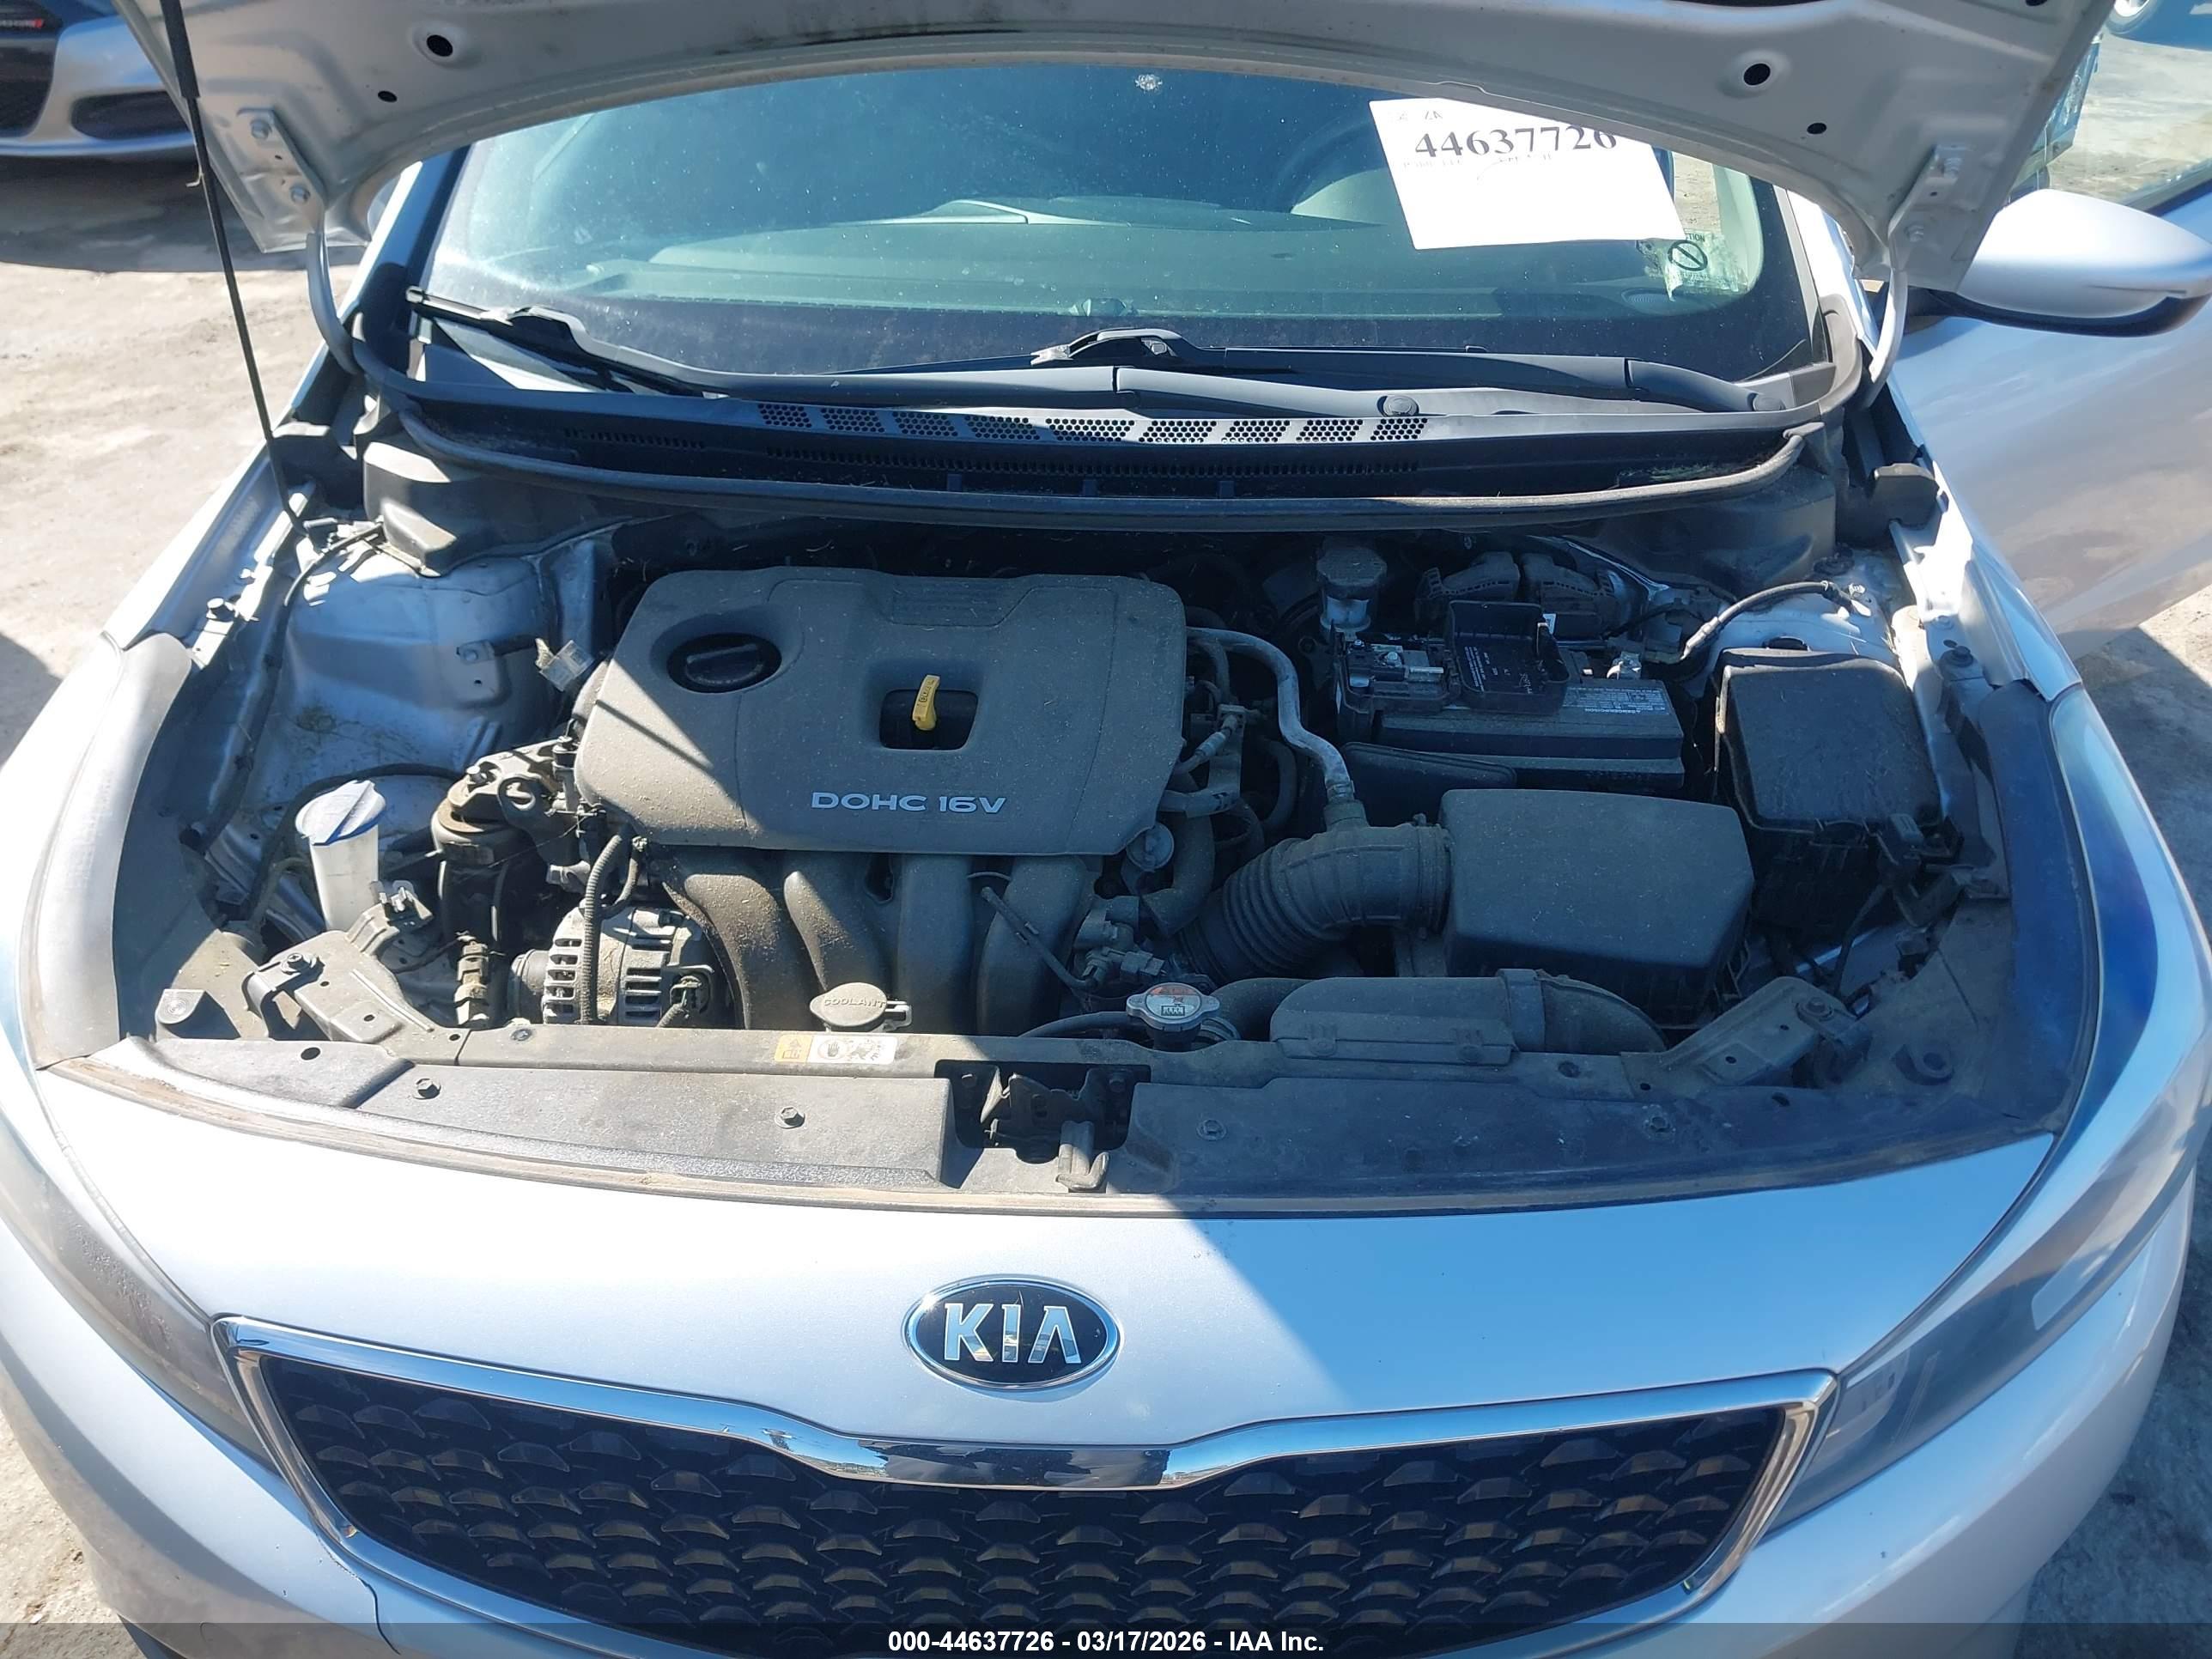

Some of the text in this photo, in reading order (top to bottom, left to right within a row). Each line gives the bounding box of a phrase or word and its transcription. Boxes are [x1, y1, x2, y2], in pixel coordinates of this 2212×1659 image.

[1415, 125, 1617, 157] 44637726
[811, 792, 1006, 813] DOHC 16V
[823, 996, 885, 1009] COOLANT
[944, 1303, 1081, 1364] KIA
